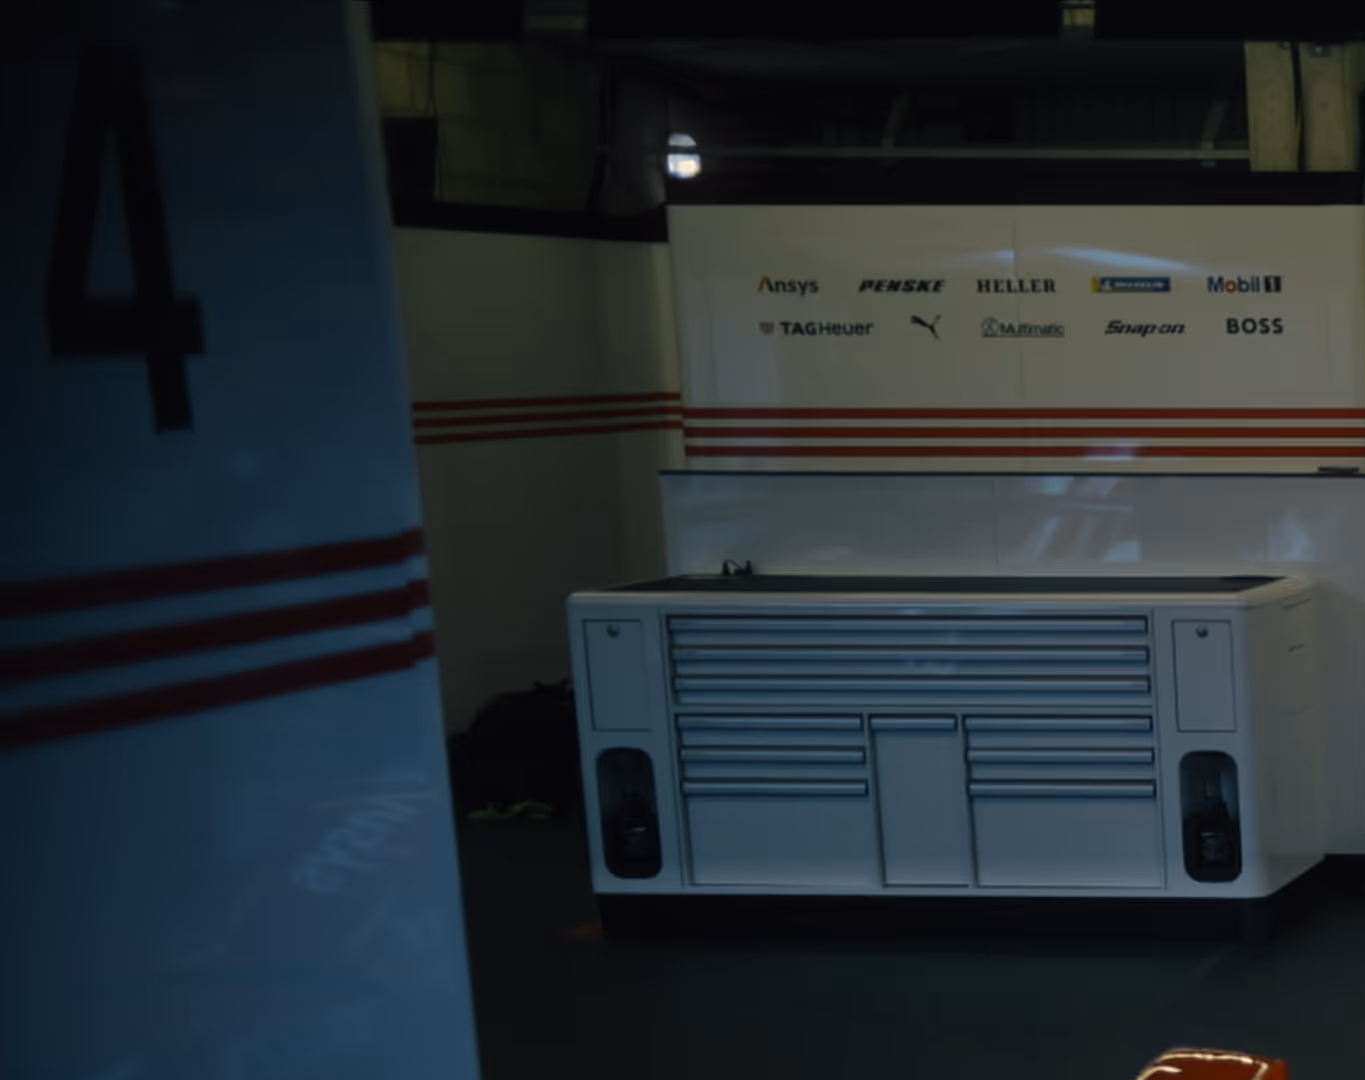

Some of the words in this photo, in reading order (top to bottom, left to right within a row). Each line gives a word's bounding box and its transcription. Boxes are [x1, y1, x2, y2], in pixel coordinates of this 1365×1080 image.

[44, 46, 206, 434] 4
[757, 275, 819, 296] Ansys
[858, 278, 945, 294] PENSKE
[976, 278, 1056, 294] HELLER
[1207, 275, 1261, 294] Mobil
[1104, 319, 1186, 336] Snap-on
[1226, 318, 1284, 335] BOSS
